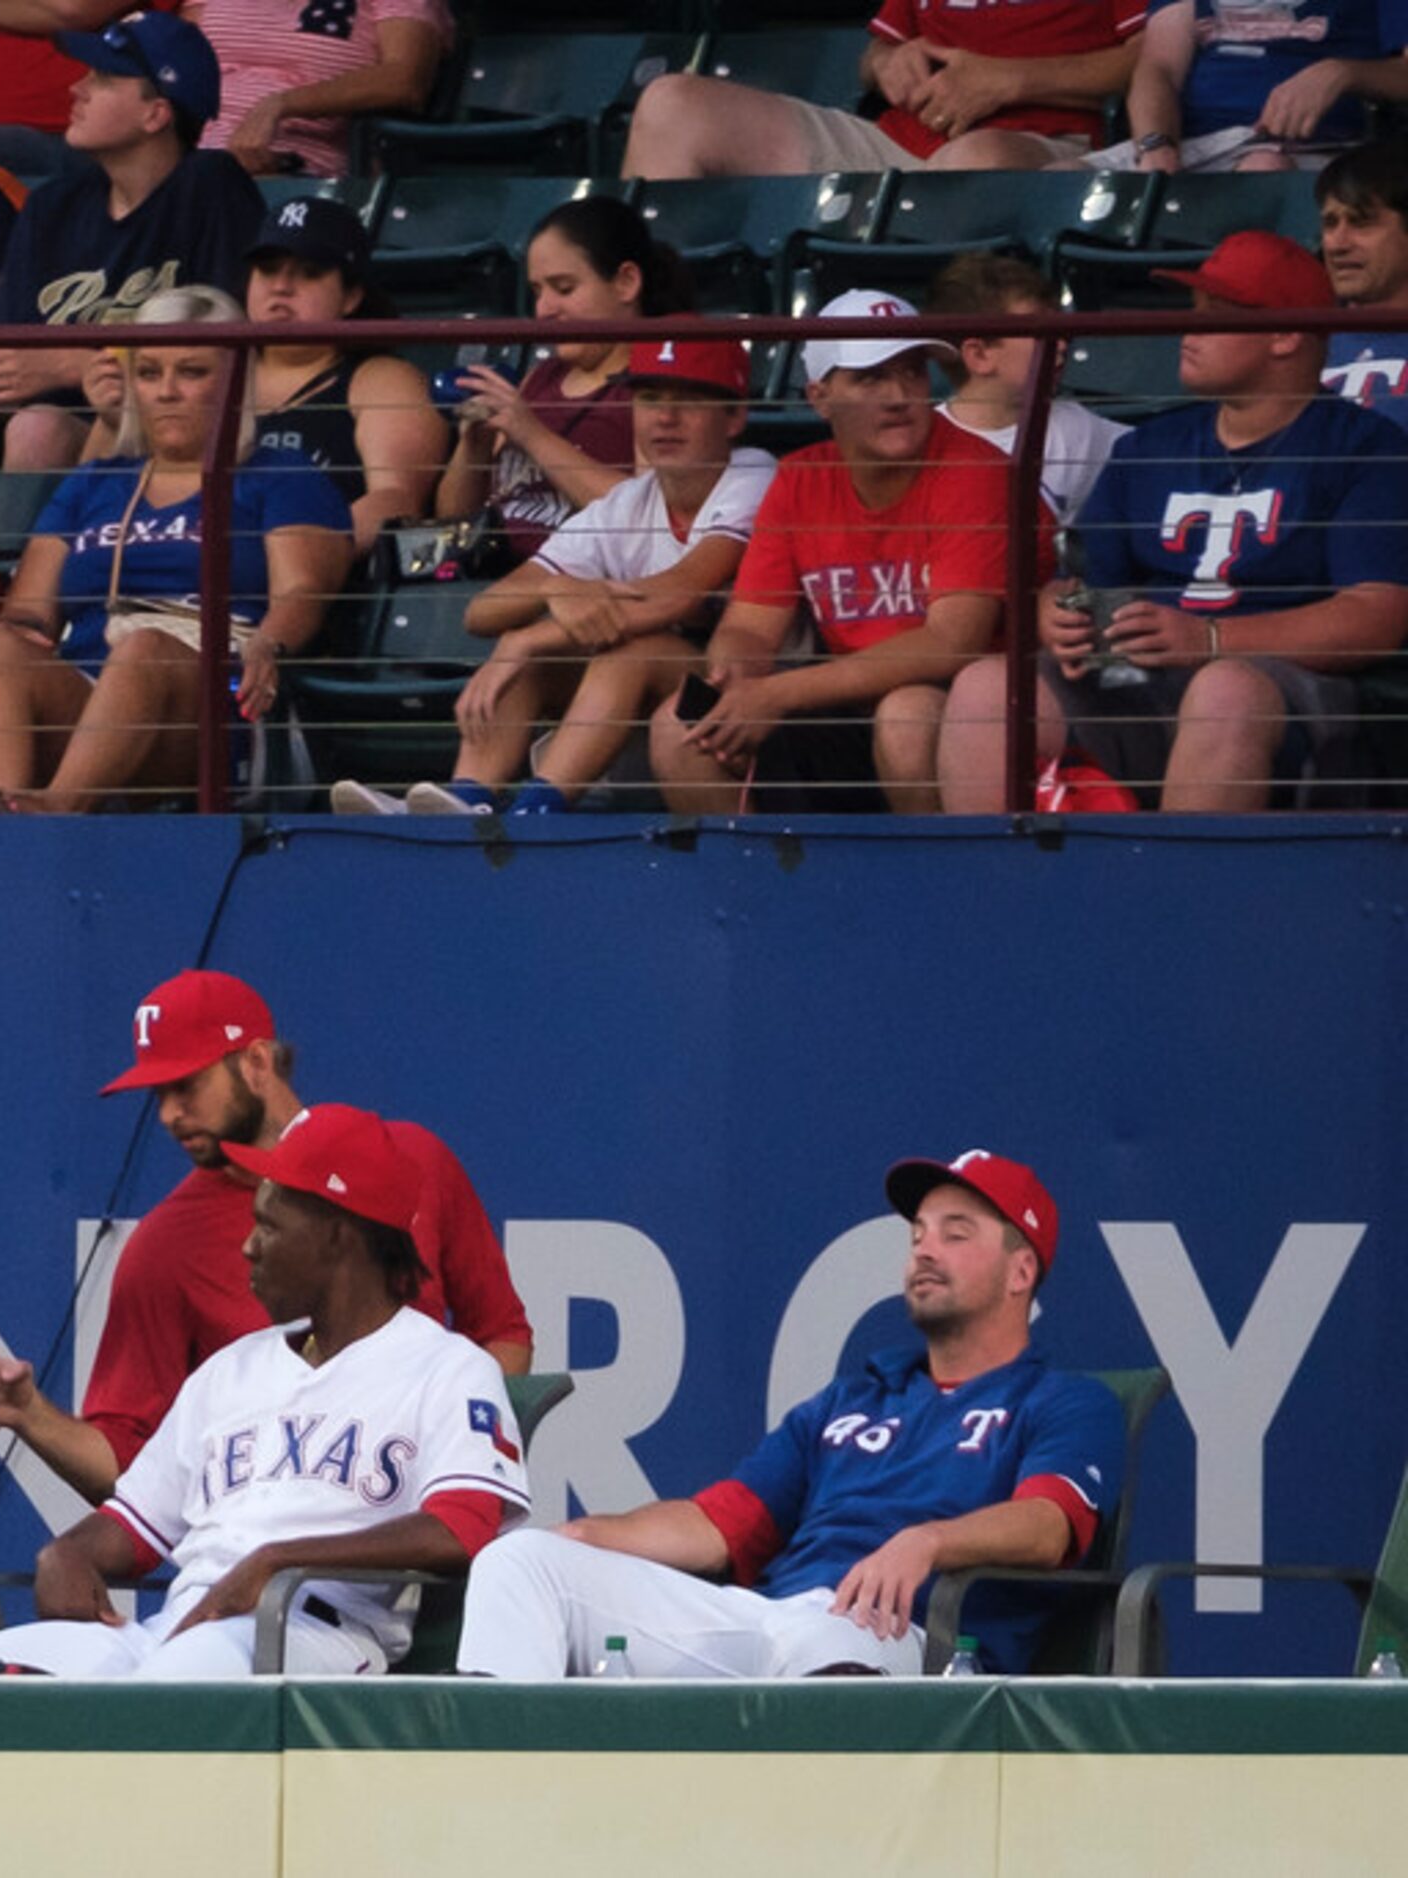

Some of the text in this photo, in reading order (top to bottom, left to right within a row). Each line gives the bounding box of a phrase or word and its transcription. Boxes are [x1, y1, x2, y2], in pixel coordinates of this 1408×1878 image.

[1161, 488, 1283, 610] T
[133, 1004, 161, 1047] T
[955, 1407, 1009, 1454] T
